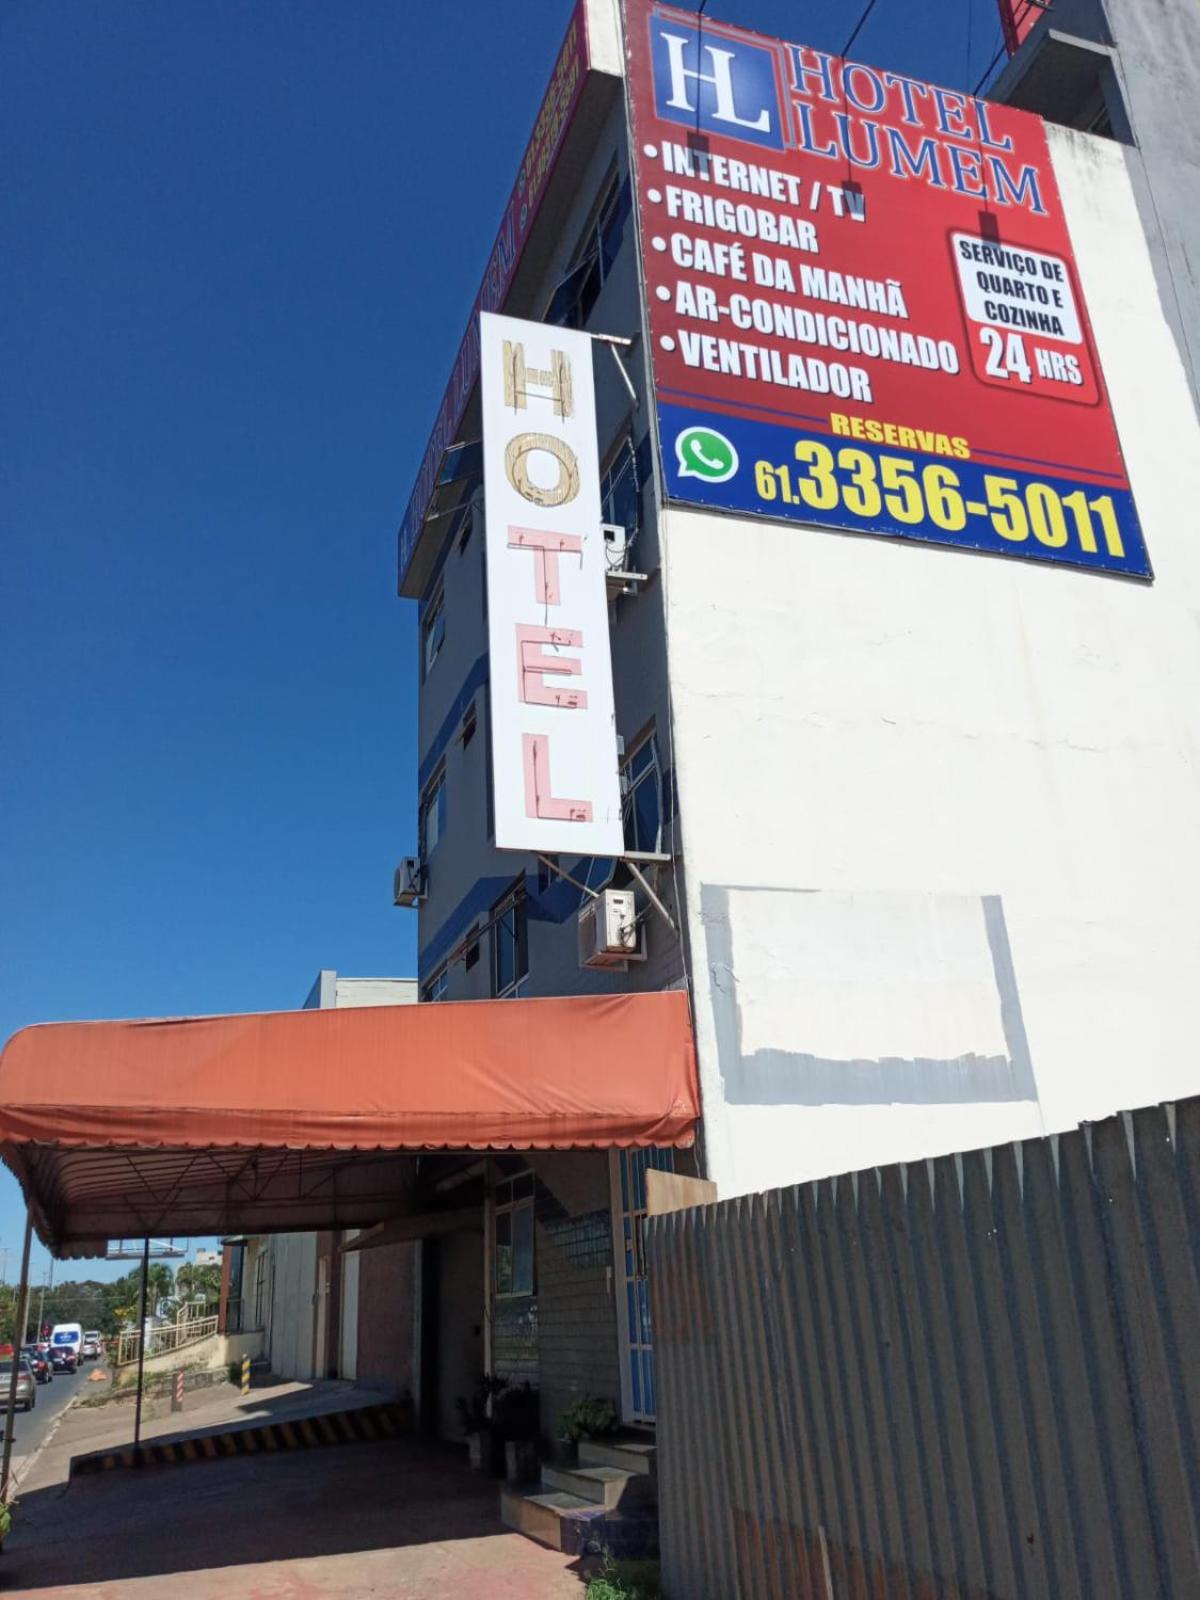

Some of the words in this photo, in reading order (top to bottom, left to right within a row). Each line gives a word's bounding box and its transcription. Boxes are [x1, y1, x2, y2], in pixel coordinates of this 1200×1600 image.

[660, 32, 770, 133] HL
[785, 42, 1013, 152] HOTEL
[661, 141, 801, 206] INTERNET
[826, 185, 865, 222] TV
[793, 100, 1048, 216] LUMEM
[665, 185, 820, 253] FRIGOBAR
[671, 232, 748, 281] CAFÉ
[752, 252, 796, 293] DA
[800, 264, 909, 318] MANHÃ
[959, 240, 1037, 276] SERVIÇO
[1040, 259, 1064, 283] DE
[976, 270, 1049, 306] QUARTO
[1051, 288, 1064, 309] E
[675, 280, 960, 375] AR-CONDICIONADO
[979, 326, 1032, 384] 24
[1034, 347, 1084, 385] HRS
[984, 300, 1065, 336] COZINHA
[677, 329, 873, 403] VENTILADOR
[829, 412, 971, 460] RESERVAS
[502, 338, 594, 824] HOTEL
